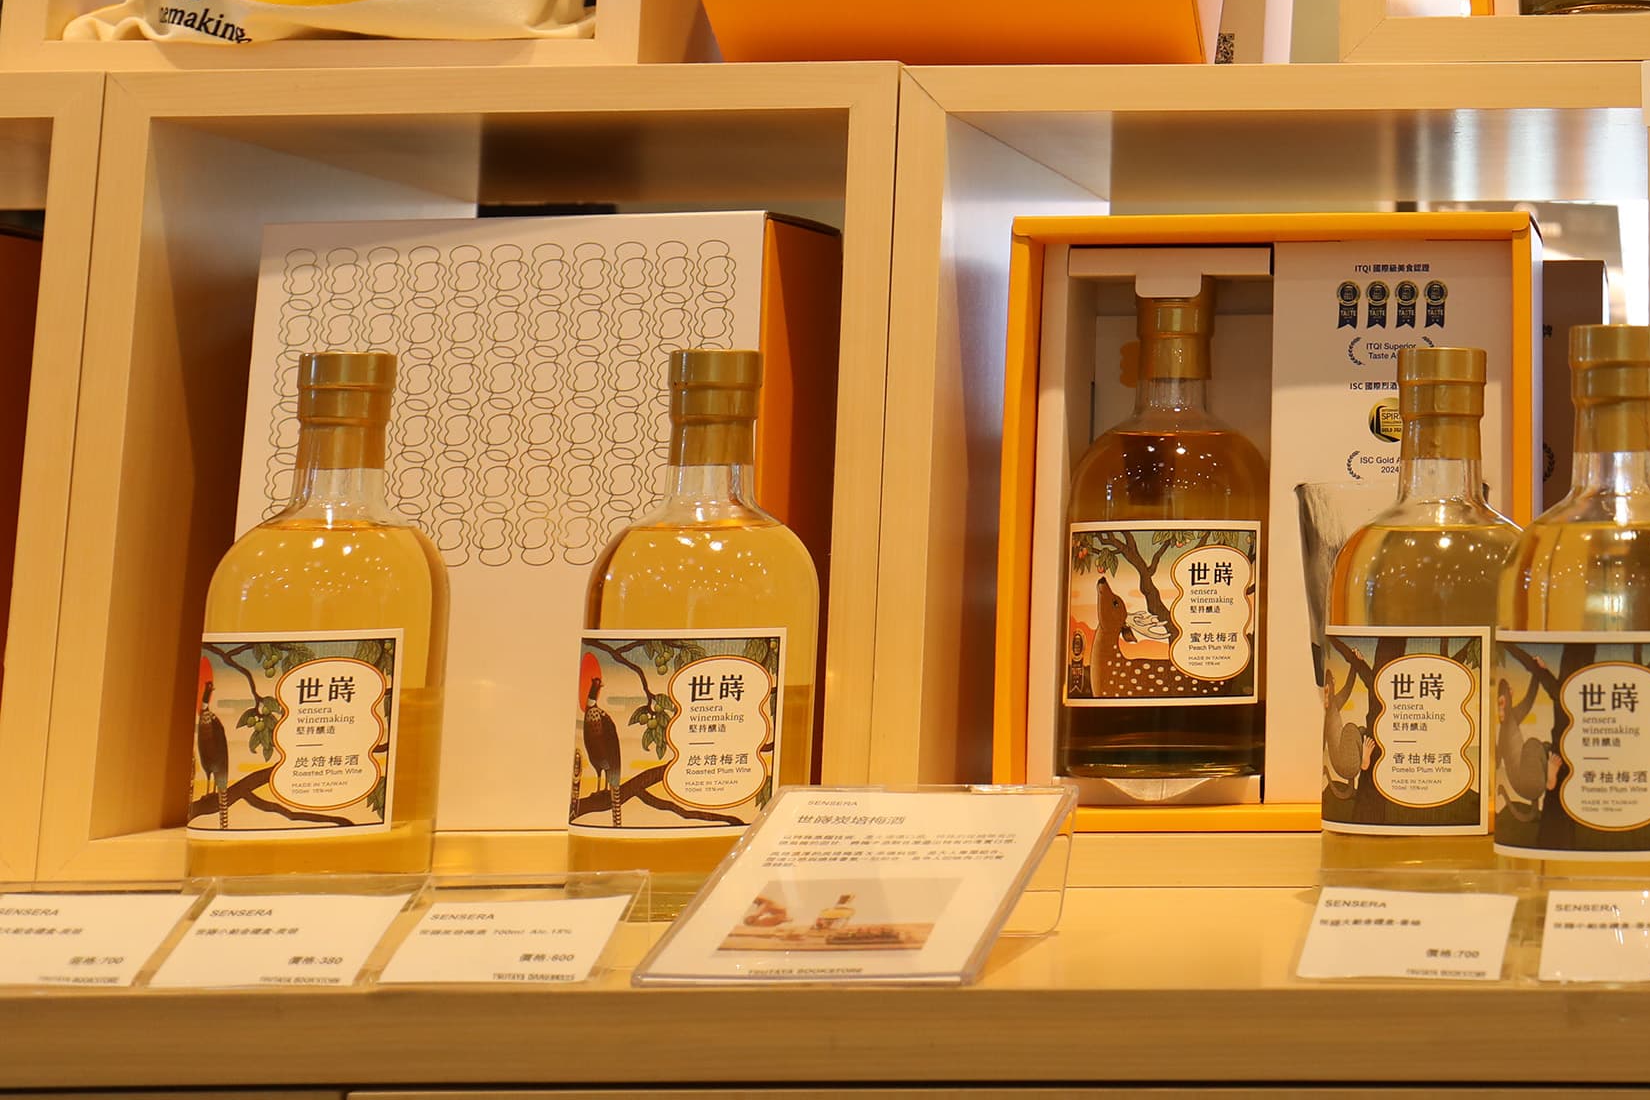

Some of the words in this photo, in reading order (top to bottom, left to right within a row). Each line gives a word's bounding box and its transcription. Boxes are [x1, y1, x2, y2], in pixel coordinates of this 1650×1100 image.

[1355, 265, 1371, 273] ITQI
[1384, 342, 1416, 350] Superior
[1369, 352, 1389, 360] Taste
[1376, 456, 1394, 464] Gold
[1188, 561, 1234, 586] 世嵵
[1190, 596, 1234, 605] winemaking
[1190, 632, 1238, 643] 蜜桃梅酒
[296, 676, 356, 705] 世嵵
[688, 674, 745, 702] 世嵵
[1391, 673, 1445, 700] 世嵵
[1579, 682, 1639, 713] 世嵵
[298, 706, 332, 714] sensera
[690, 704, 723, 712] sensera
[297, 715, 355, 725] winemaking
[689, 713, 744, 723] winemaking
[1393, 711, 1445, 721] winemaking
[1582, 716, 1616, 724] sensera
[1582, 726, 1640, 736] winemaking
[294, 755, 360, 768] 炭焙梅酒
[687, 753, 749, 766] 炭焙梅酒
[1393, 753, 1451, 765] 香柚梅酒
[292, 769, 324, 777] Roasted
[1582, 770, 1648, 784] 香柚梅酒
[1324, 900, 1387, 908] SENSERA
[1555, 904, 1617, 912] SENSERA
[210, 909, 273, 917] SENSERA
